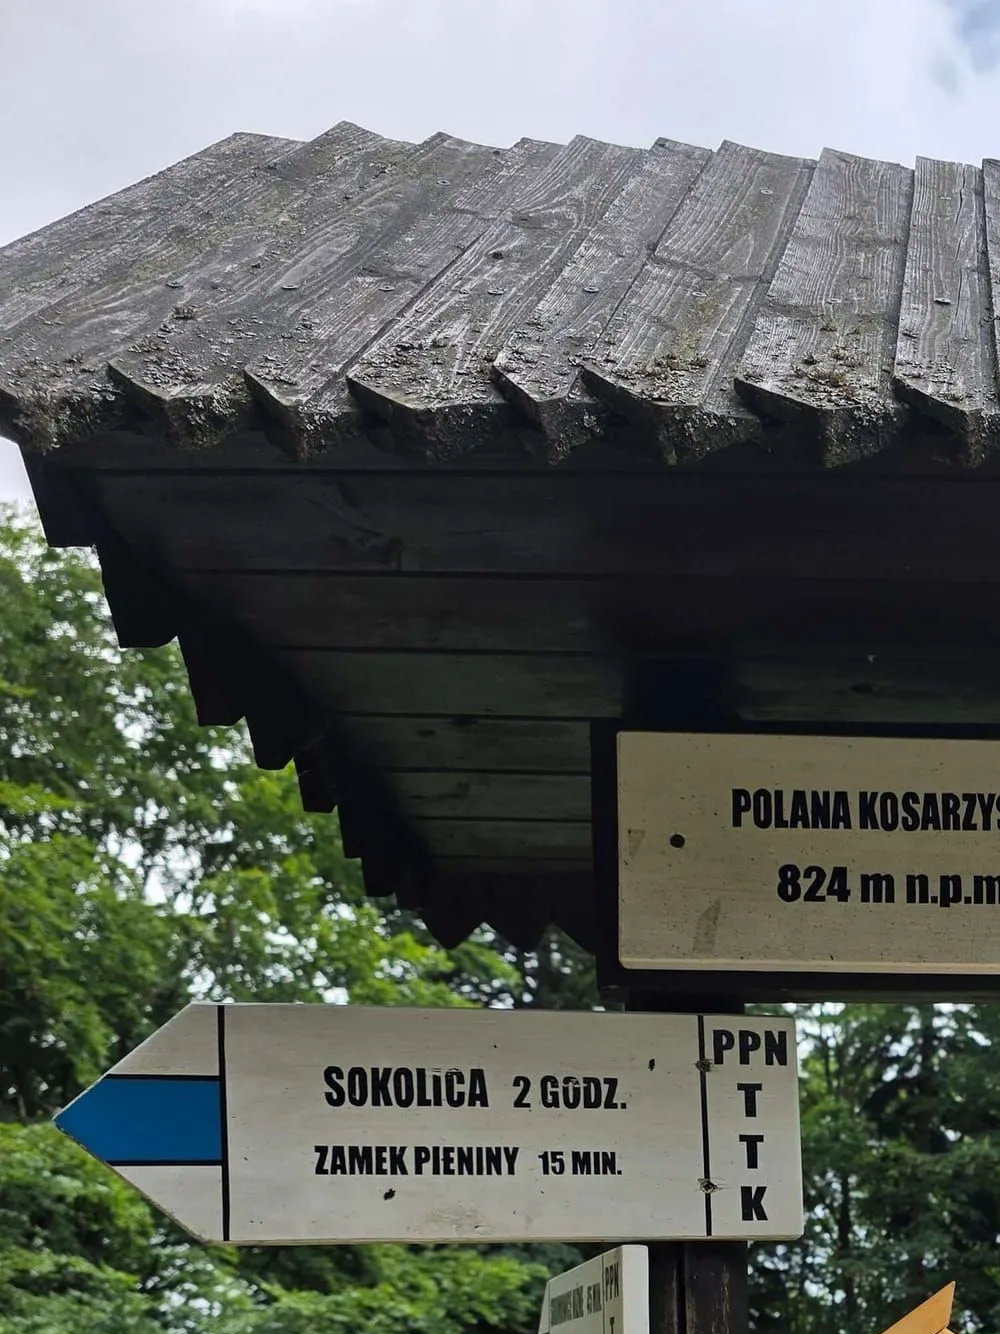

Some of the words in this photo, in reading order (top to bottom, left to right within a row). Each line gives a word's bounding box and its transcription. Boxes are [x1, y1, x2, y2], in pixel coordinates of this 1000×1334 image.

[732, 789, 851, 829] POLANA
[777, 864, 850, 902] 824
[861, 873, 894, 903] m
[713, 1030, 787, 1066] PPN
[324, 1066, 489, 1108] SOKOLICA
[513, 1076, 531, 1108] 2
[541, 1076, 627, 1109] GODZ.
[314, 1145, 408, 1175] ZAMEK
[414, 1146, 519, 1175] PIENINY
[538, 1151, 565, 1175] 15
[572, 1151, 622, 1175] MIN.
[605, 1262, 619, 1301] PPN
